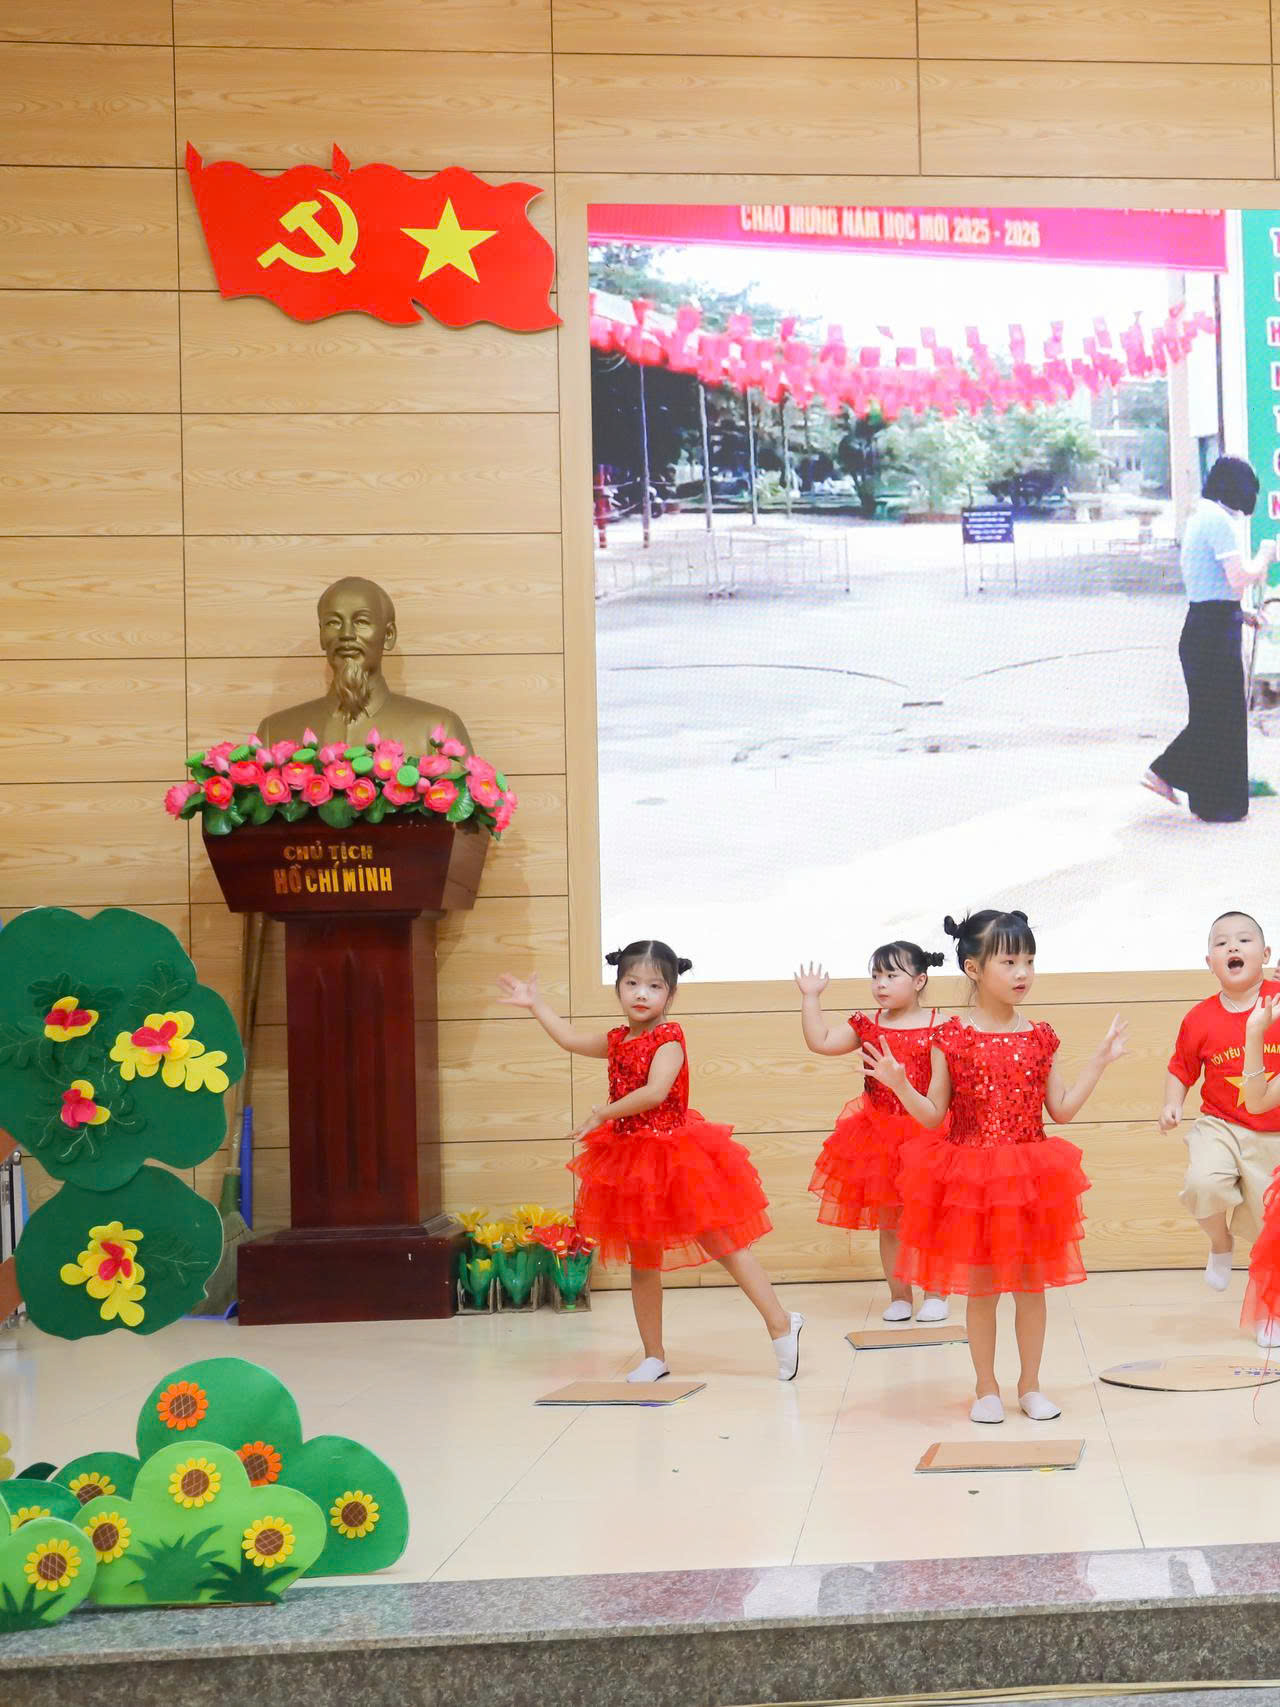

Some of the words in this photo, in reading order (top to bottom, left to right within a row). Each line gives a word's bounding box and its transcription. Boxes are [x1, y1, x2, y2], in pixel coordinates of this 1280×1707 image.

[952, 216, 990, 244] 2025
[1004, 219, 1041, 247] 2026
[283, 840, 324, 861] CHỦ
[327, 842, 374, 863] TỊCH
[273, 863, 303, 894] HỒ
[304, 860, 340, 893] CHÍ
[1224, 1047, 1241, 1061] YÊU
